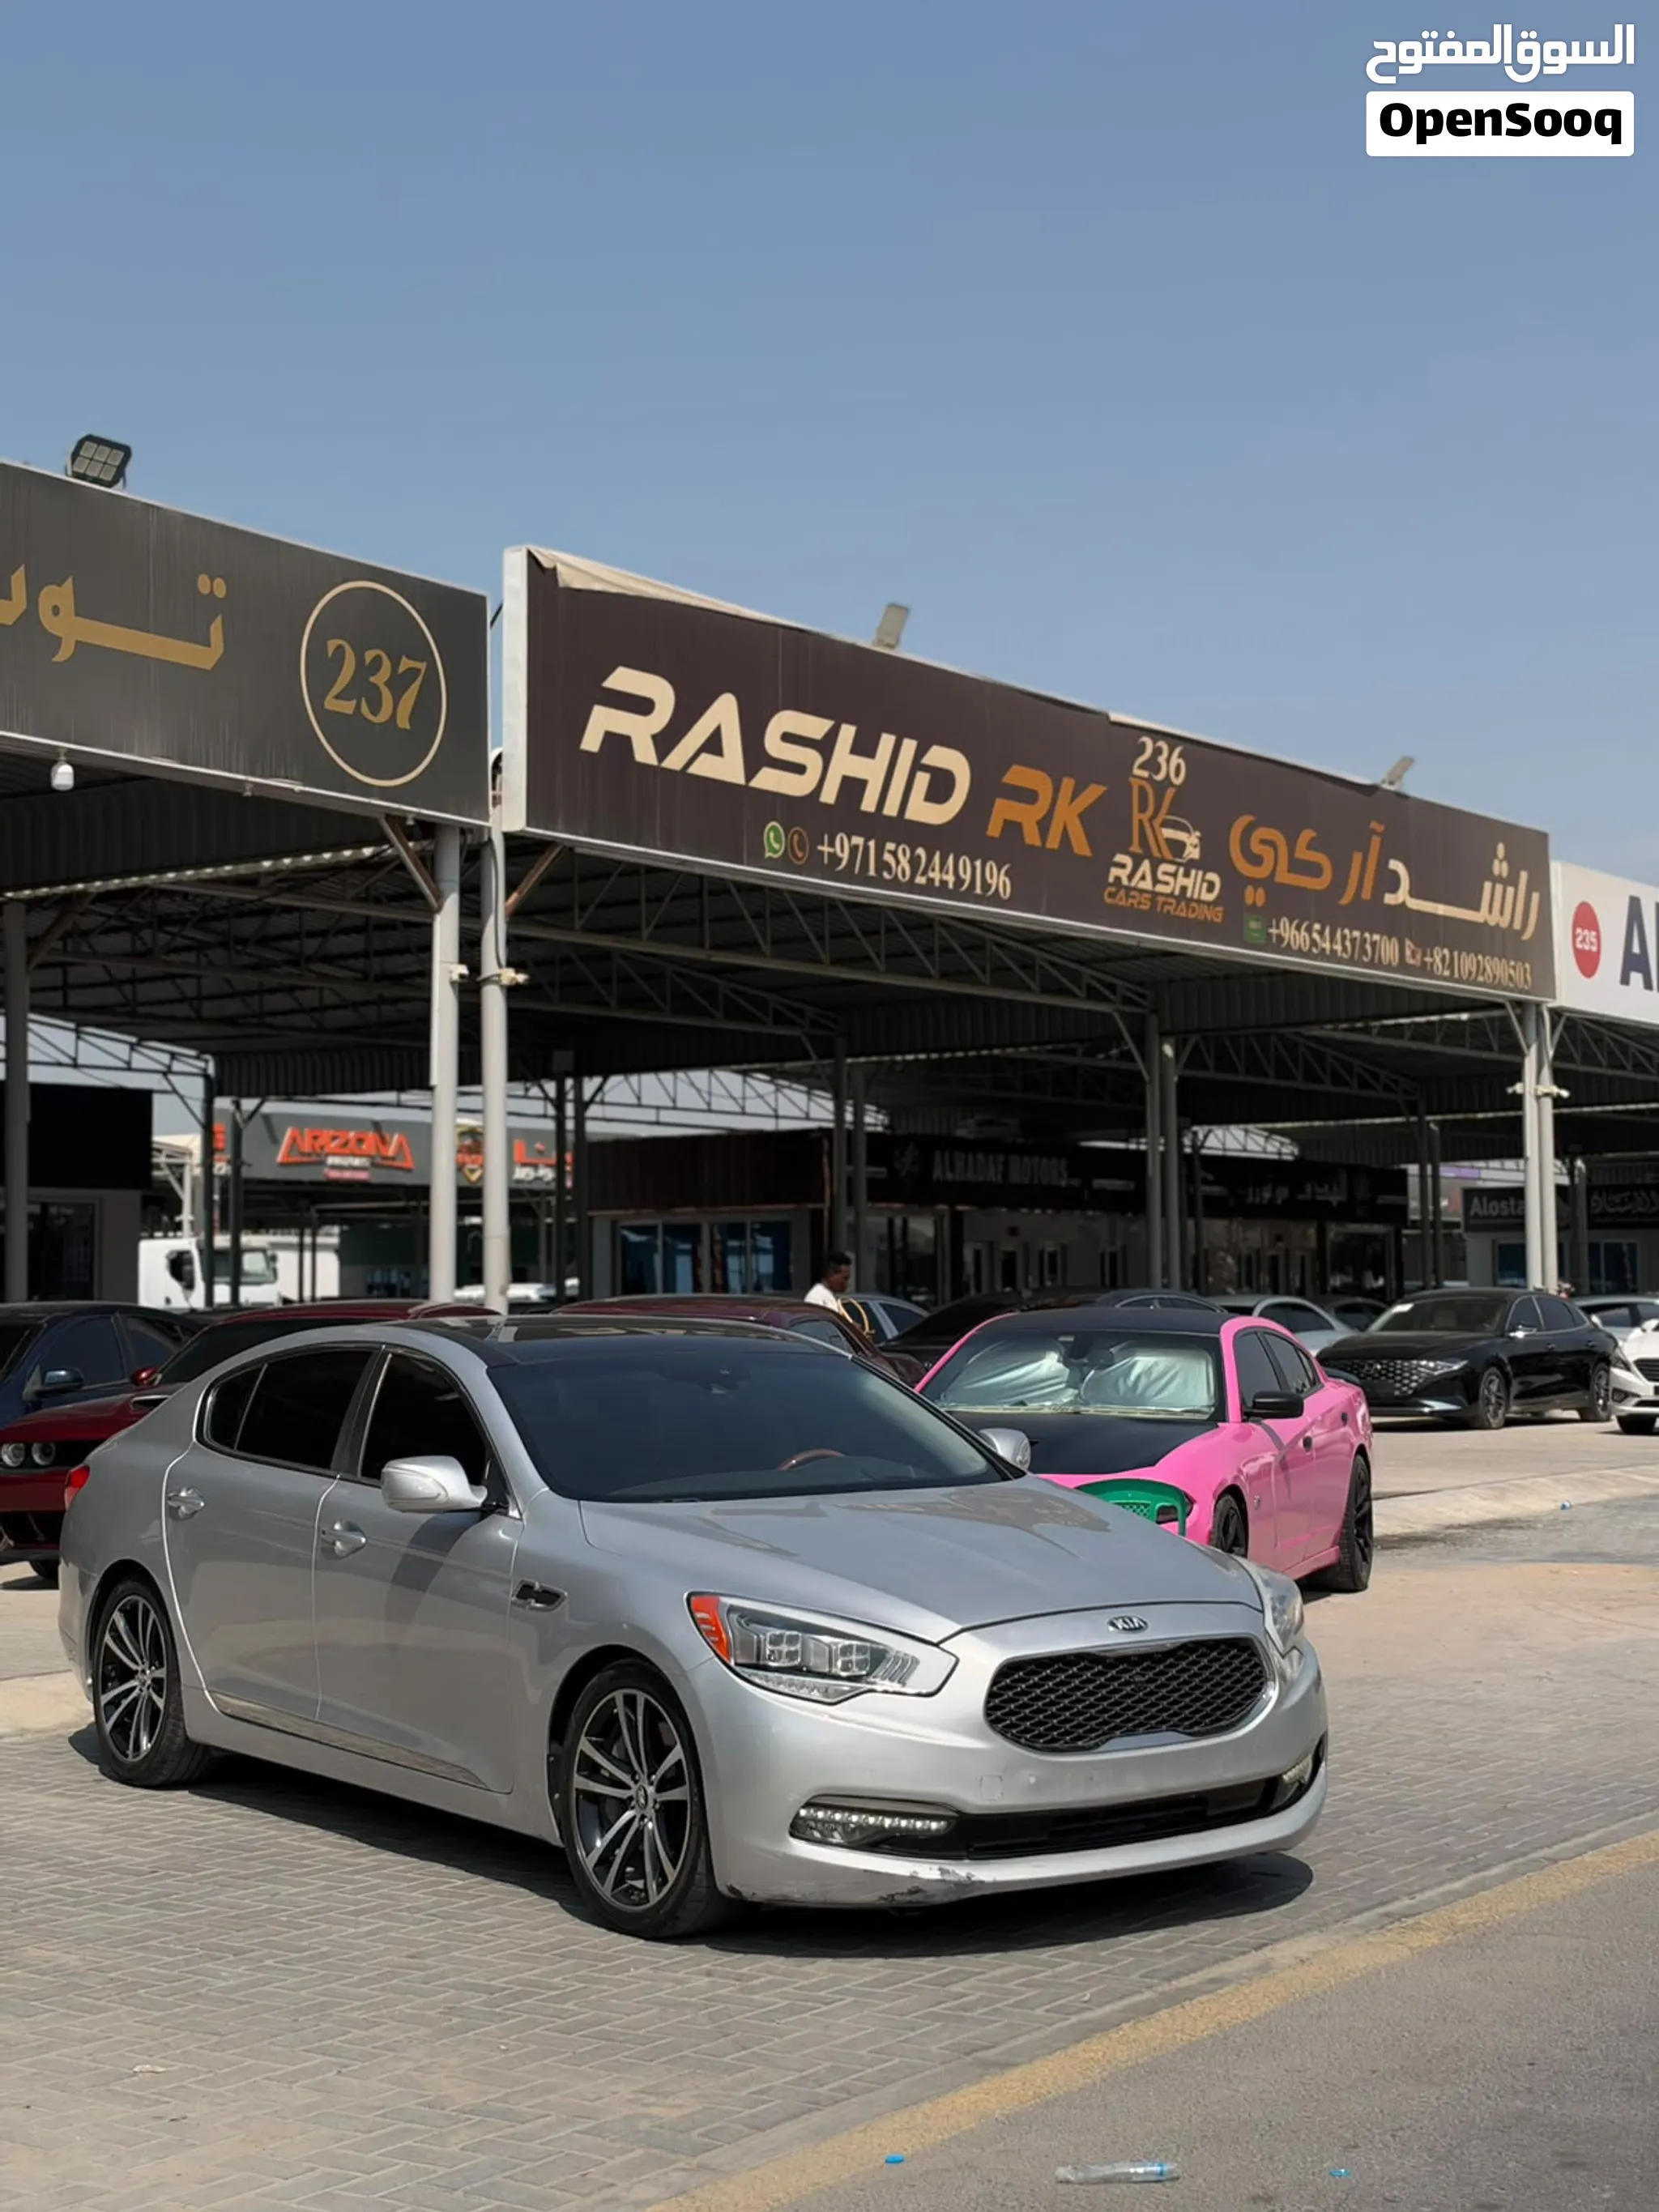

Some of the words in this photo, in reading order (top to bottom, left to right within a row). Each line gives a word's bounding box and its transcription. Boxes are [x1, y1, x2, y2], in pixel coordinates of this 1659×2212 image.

[324, 638, 427, 729] 237
[579, 665, 971, 825] RASHID
[986, 765, 1107, 857] RK
[1132, 735, 1187, 786] 236
[1107, 853, 1222, 902] RASHID
[1384, 842, 1540, 941] راشد
[1103, 886, 1151, 910] CARS
[1156, 895, 1225, 923] TRADING
[1575, 927, 1598, 953] 235
[1619, 894, 1659, 993] A
[275, 1127, 415, 1170] ARIZONA
